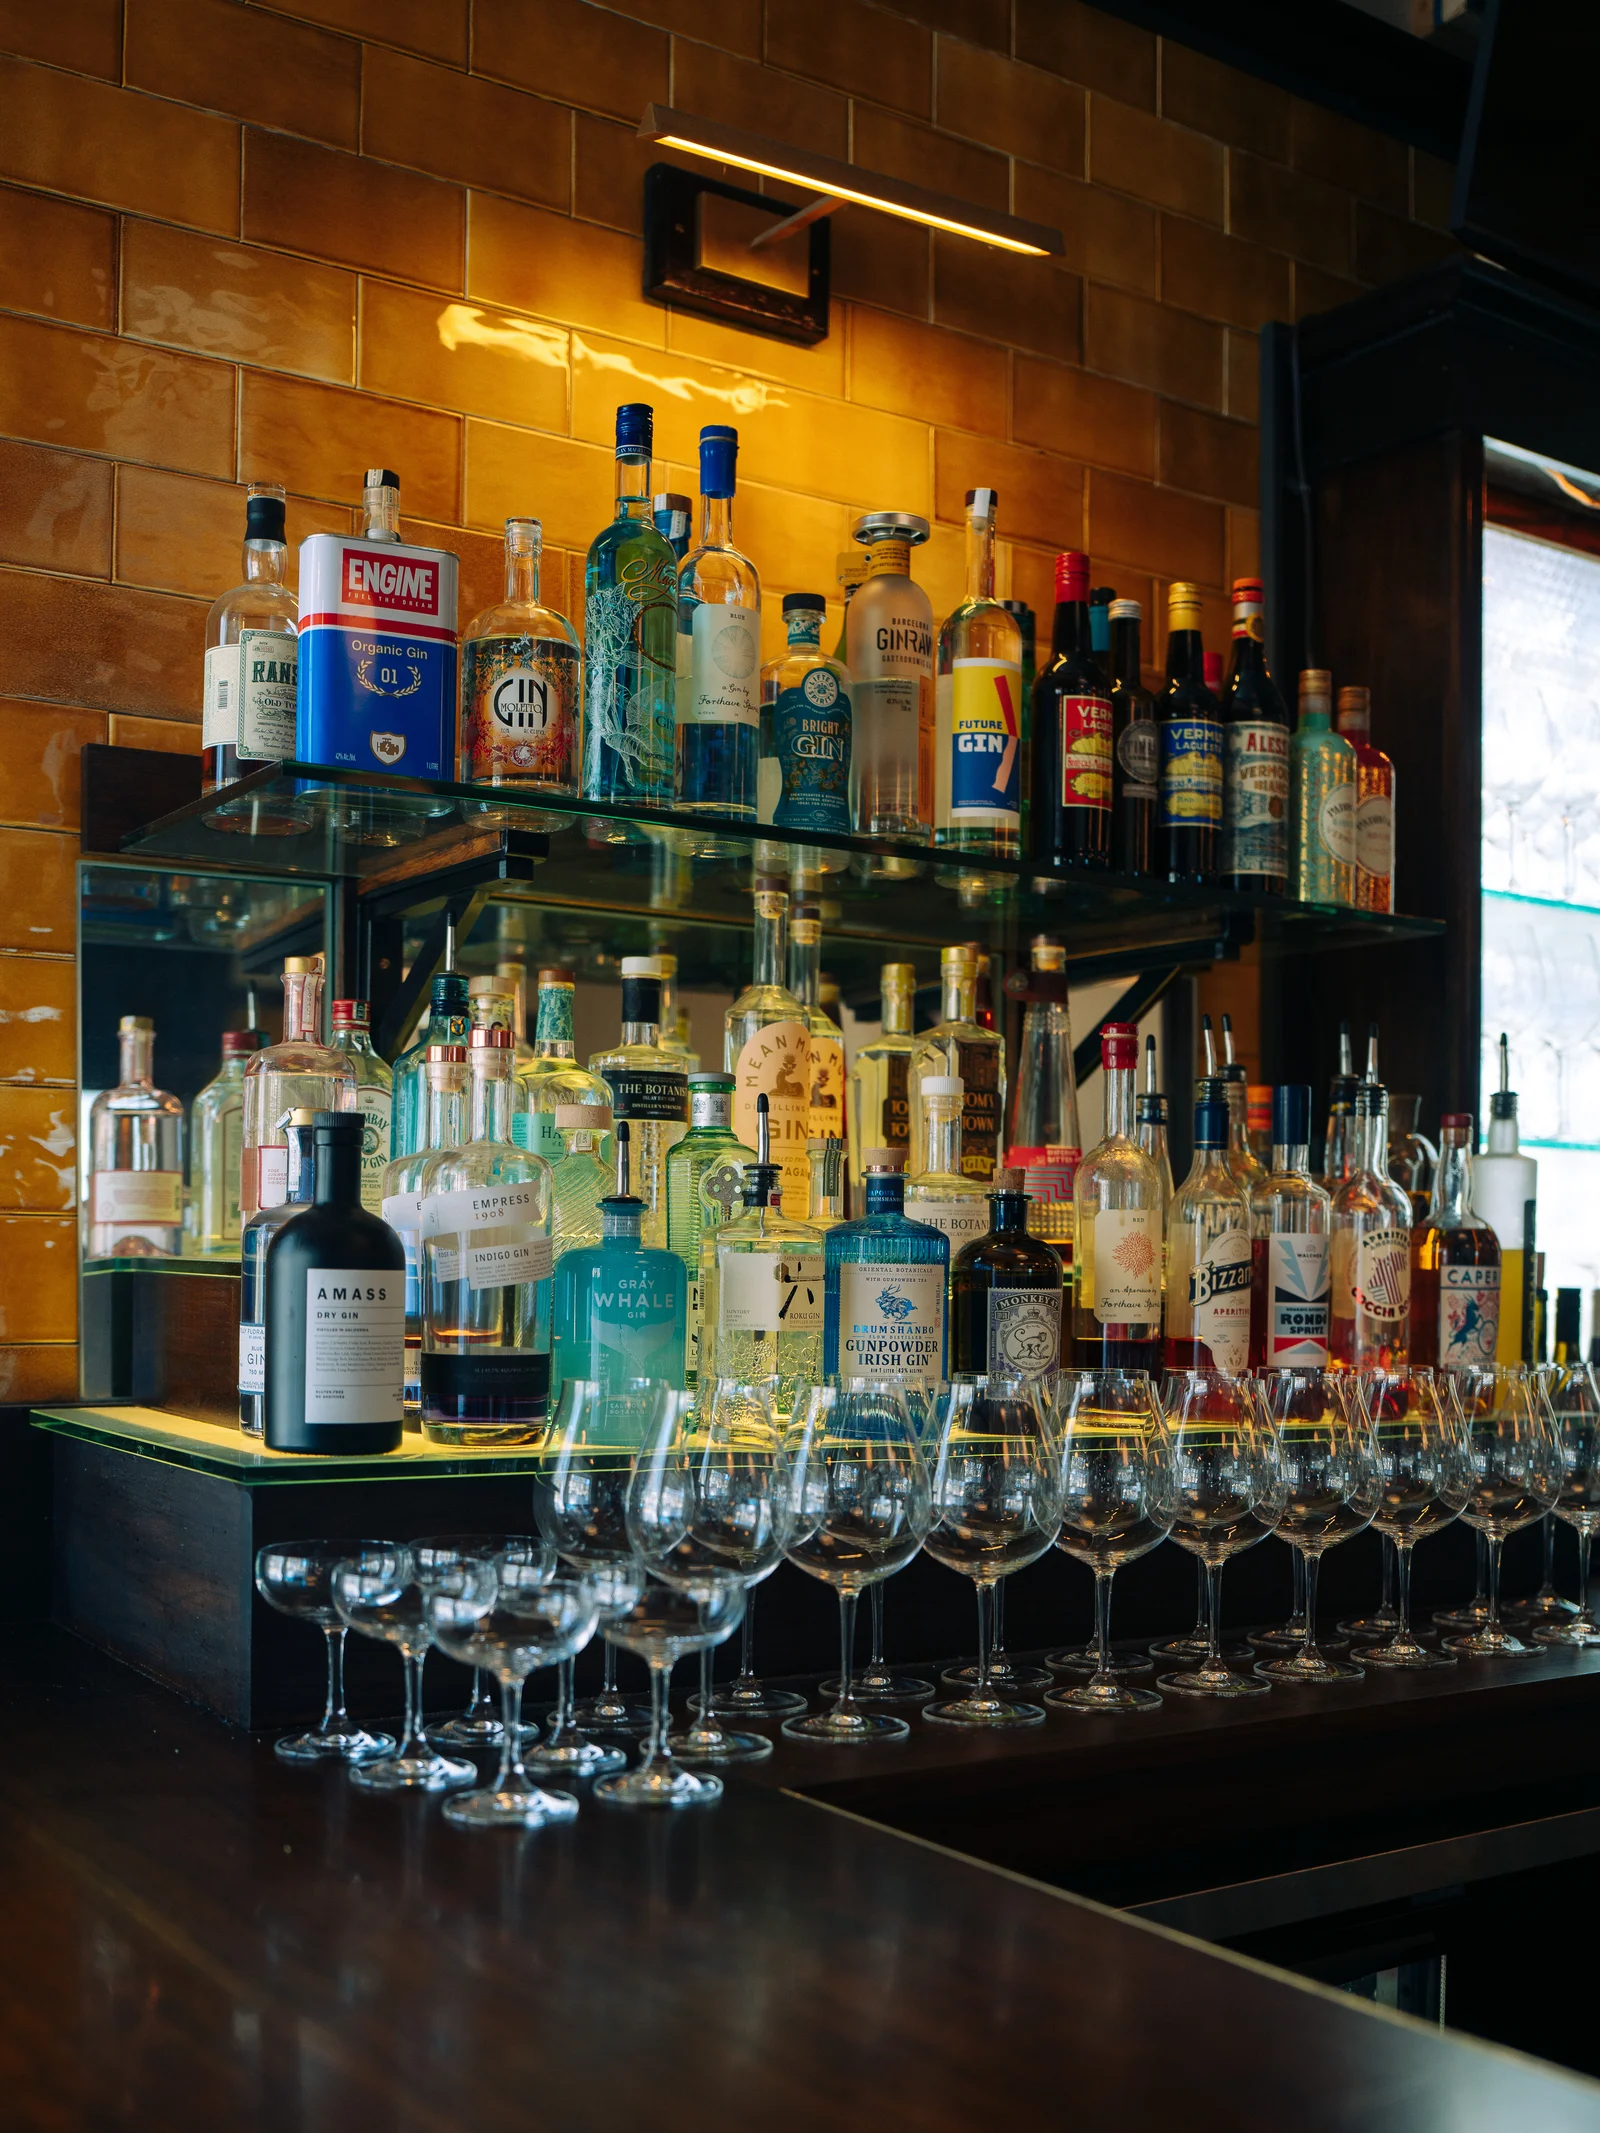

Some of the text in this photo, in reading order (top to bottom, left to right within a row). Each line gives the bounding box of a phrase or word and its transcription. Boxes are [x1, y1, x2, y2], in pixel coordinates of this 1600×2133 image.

[348, 558, 432, 601] ENGINE
[348, 592, 371, 600] FUEL
[403, 600, 433, 609] DREAM
[892, 617, 929, 630] BARCELONA
[352, 639, 428, 660] Organic Gin
[882, 655, 925, 668] GASTRONOMIC
[381, 668, 398, 684] 01
[808, 674, 834, 688] LIFTED
[728, 683, 742, 694] Gin
[264, 698, 281, 706] OLD
[494, 679, 547, 728] GIN
[808, 690, 834, 705] SPIRITS
[802, 719, 839, 734] BRIGHT
[959, 720, 1003, 730] FUTURE
[791, 734, 844, 761] GIN
[958, 734, 1003, 753] GIN
[745, 1034, 787, 1087] MEAN
[617, 1083, 688, 1097] THE BOTANIST
[745, 1103, 806, 1113] DIILLING
[756, 1118, 808, 1140] GIN
[370, 1153, 388, 1169] GIN
[965, 1158, 988, 1169] GIN
[473, 1193, 530, 1210] EMPRESS
[474, 1207, 505, 1222] 1908
[920, 1218, 948, 1229] THE
[475, 1248, 529, 1262] INDIGO GIN
[618, 1279, 655, 1289] GRAY
[317, 1288, 387, 1301] AMASS
[594, 1292, 674, 1308] WHALE
[1000, 1294, 1058, 1309] MONKEY 47
[1101, 1297, 1141, 1308] Forthave
[1351, 1286, 1395, 1318] COCCHI
[317, 1311, 359, 1319] DRY GIN
[627, 1311, 646, 1319] GIN
[789, 1312, 821, 1320] ROKU GIN
[853, 1325, 934, 1334] DRUMSHANBO
[846, 1339, 938, 1352] GUNPOWDER
[858, 1353, 901, 1366] IRISH
